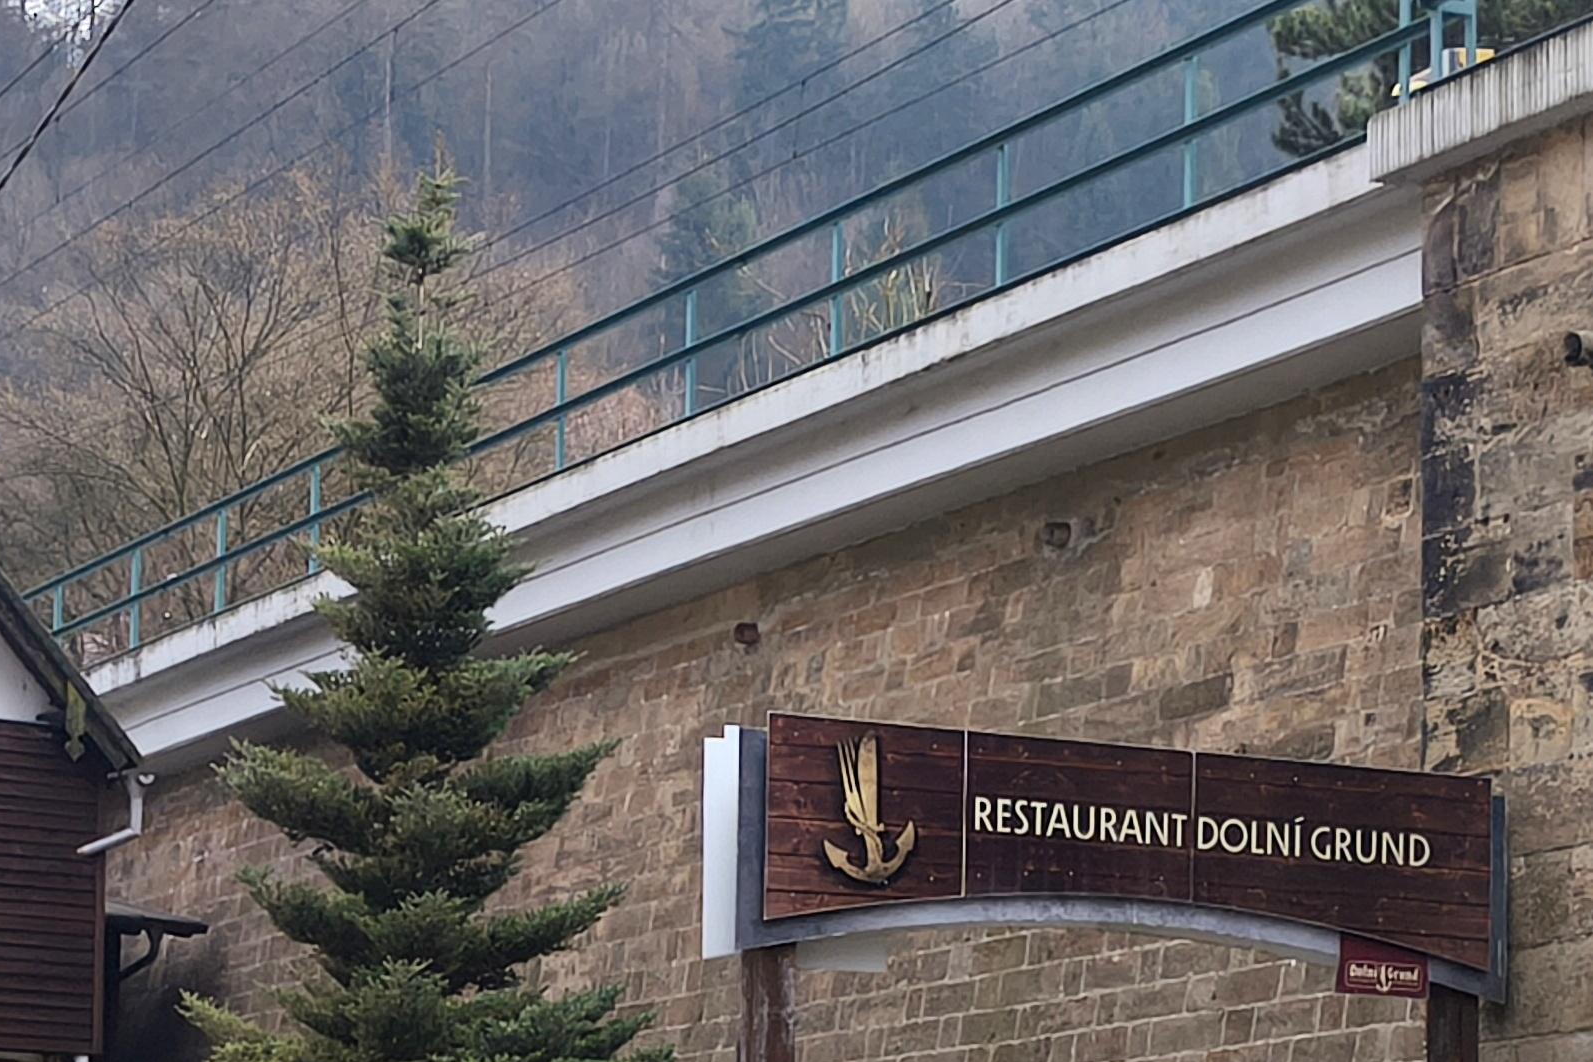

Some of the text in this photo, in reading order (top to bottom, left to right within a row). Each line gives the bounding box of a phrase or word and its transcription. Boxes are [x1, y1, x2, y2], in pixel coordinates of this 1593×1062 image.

[974, 796, 1430, 867] RESTAURANT DOLNÍ GRUND
